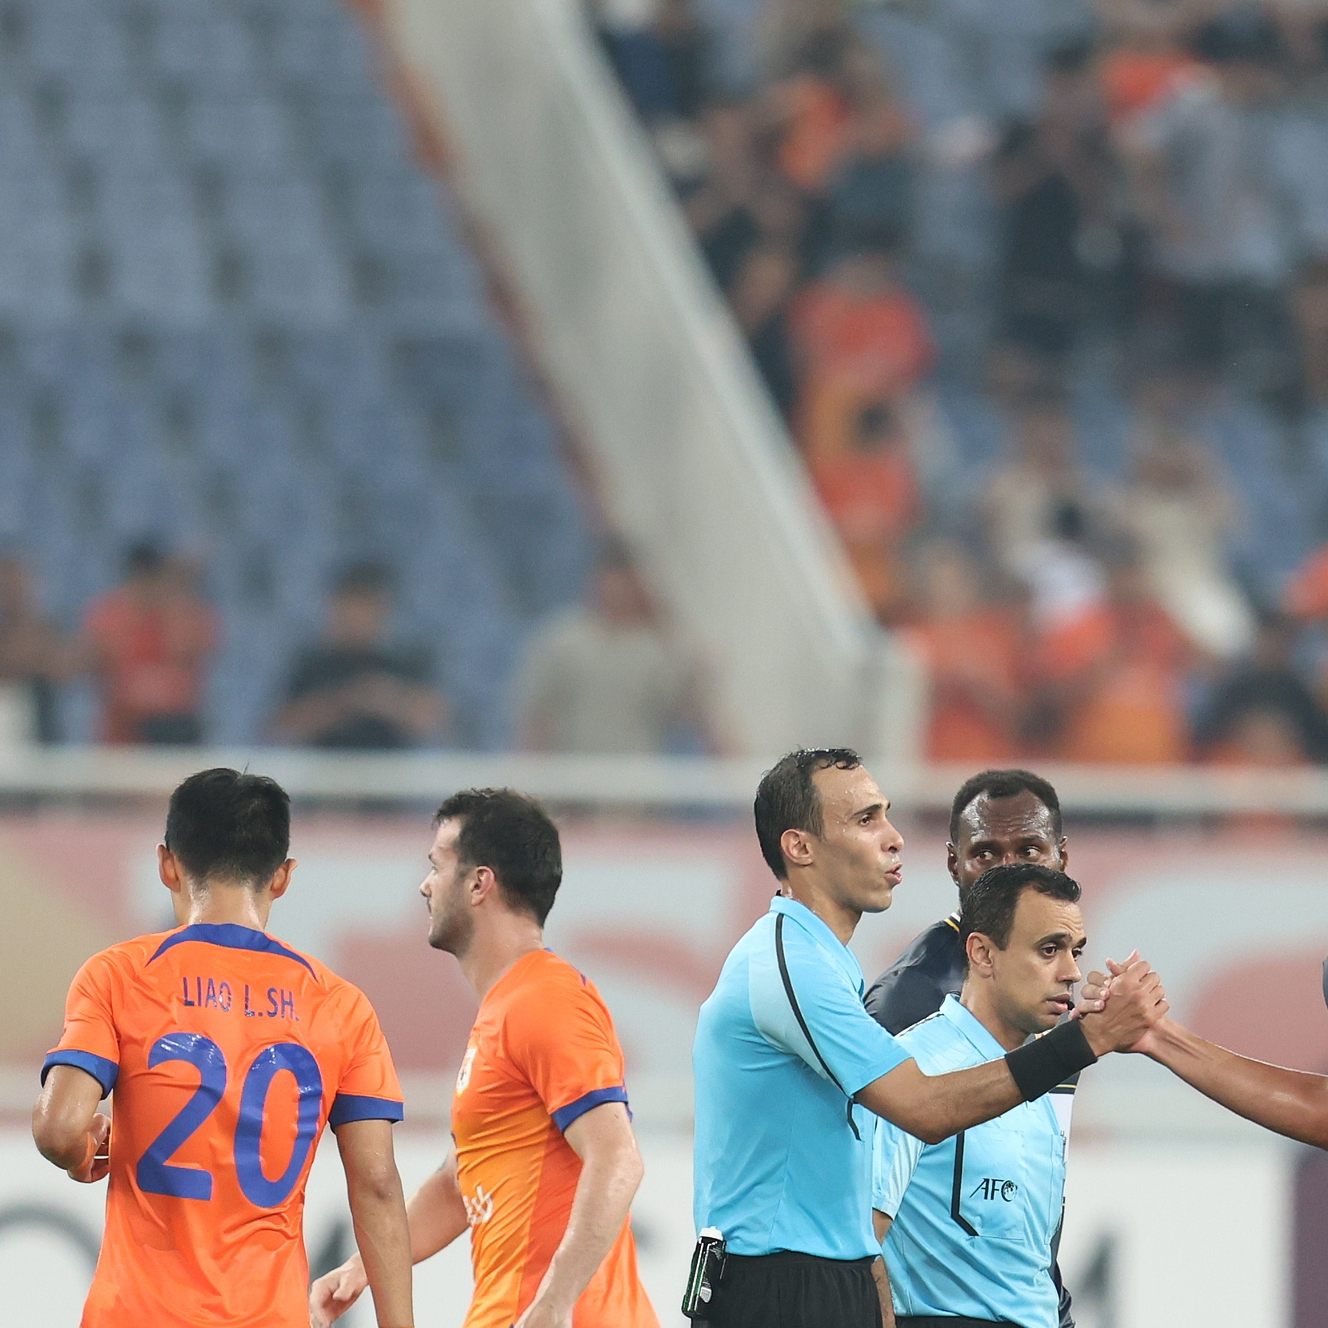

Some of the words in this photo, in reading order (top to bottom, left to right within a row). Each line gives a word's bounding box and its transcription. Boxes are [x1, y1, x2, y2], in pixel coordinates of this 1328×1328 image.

[183, 976, 232, 1012] LIAO
[137, 1032, 322, 1208] 20
[969, 1177, 1018, 1203] AFC
